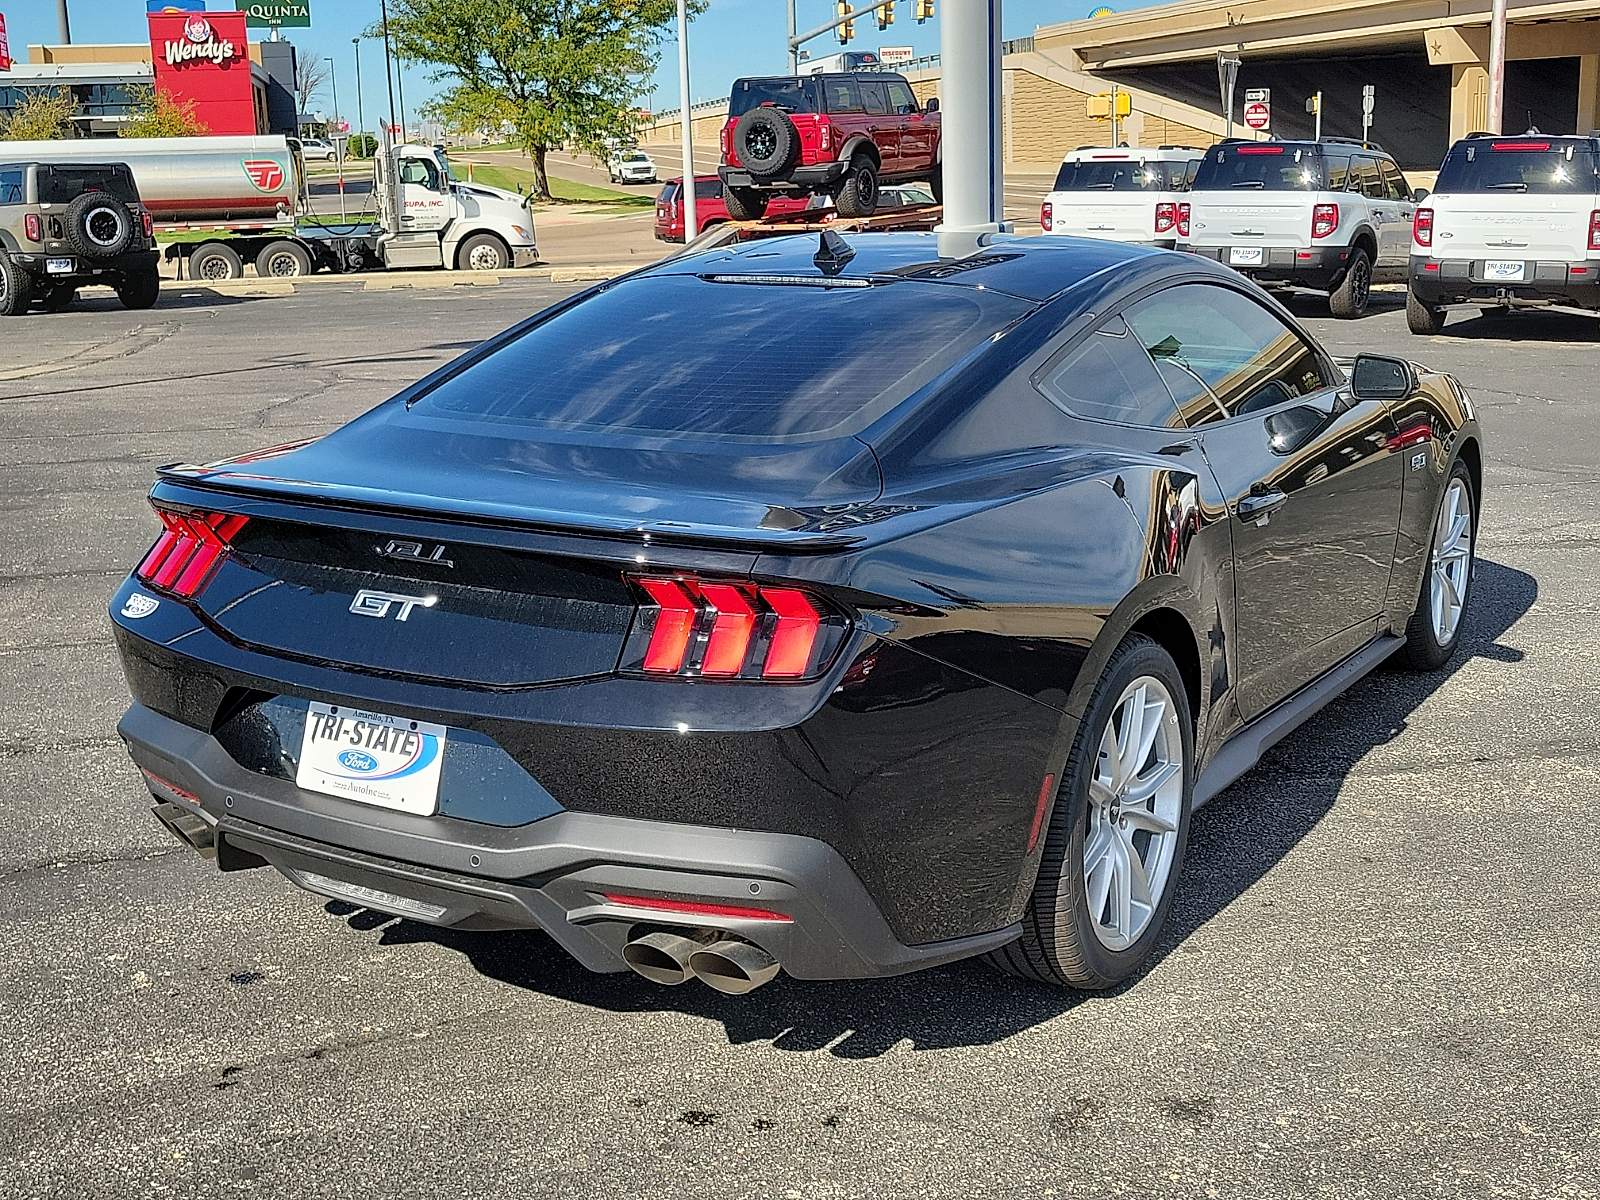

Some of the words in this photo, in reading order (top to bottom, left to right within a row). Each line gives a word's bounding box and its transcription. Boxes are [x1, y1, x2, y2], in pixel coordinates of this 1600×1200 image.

[250, 4, 308, 20] QUINTA
[165, 35, 233, 65] Wendy's
[1486, 263, 1517, 271] TRI-STATE
[349, 589, 438, 622] GT
[352, 710, 384, 723] Amarillo,
[384, 715, 396, 724] TX
[311, 712, 419, 757] TRI-STATE
[344, 752, 371, 770] Ford
[347, 782, 378, 797] AutoInc
